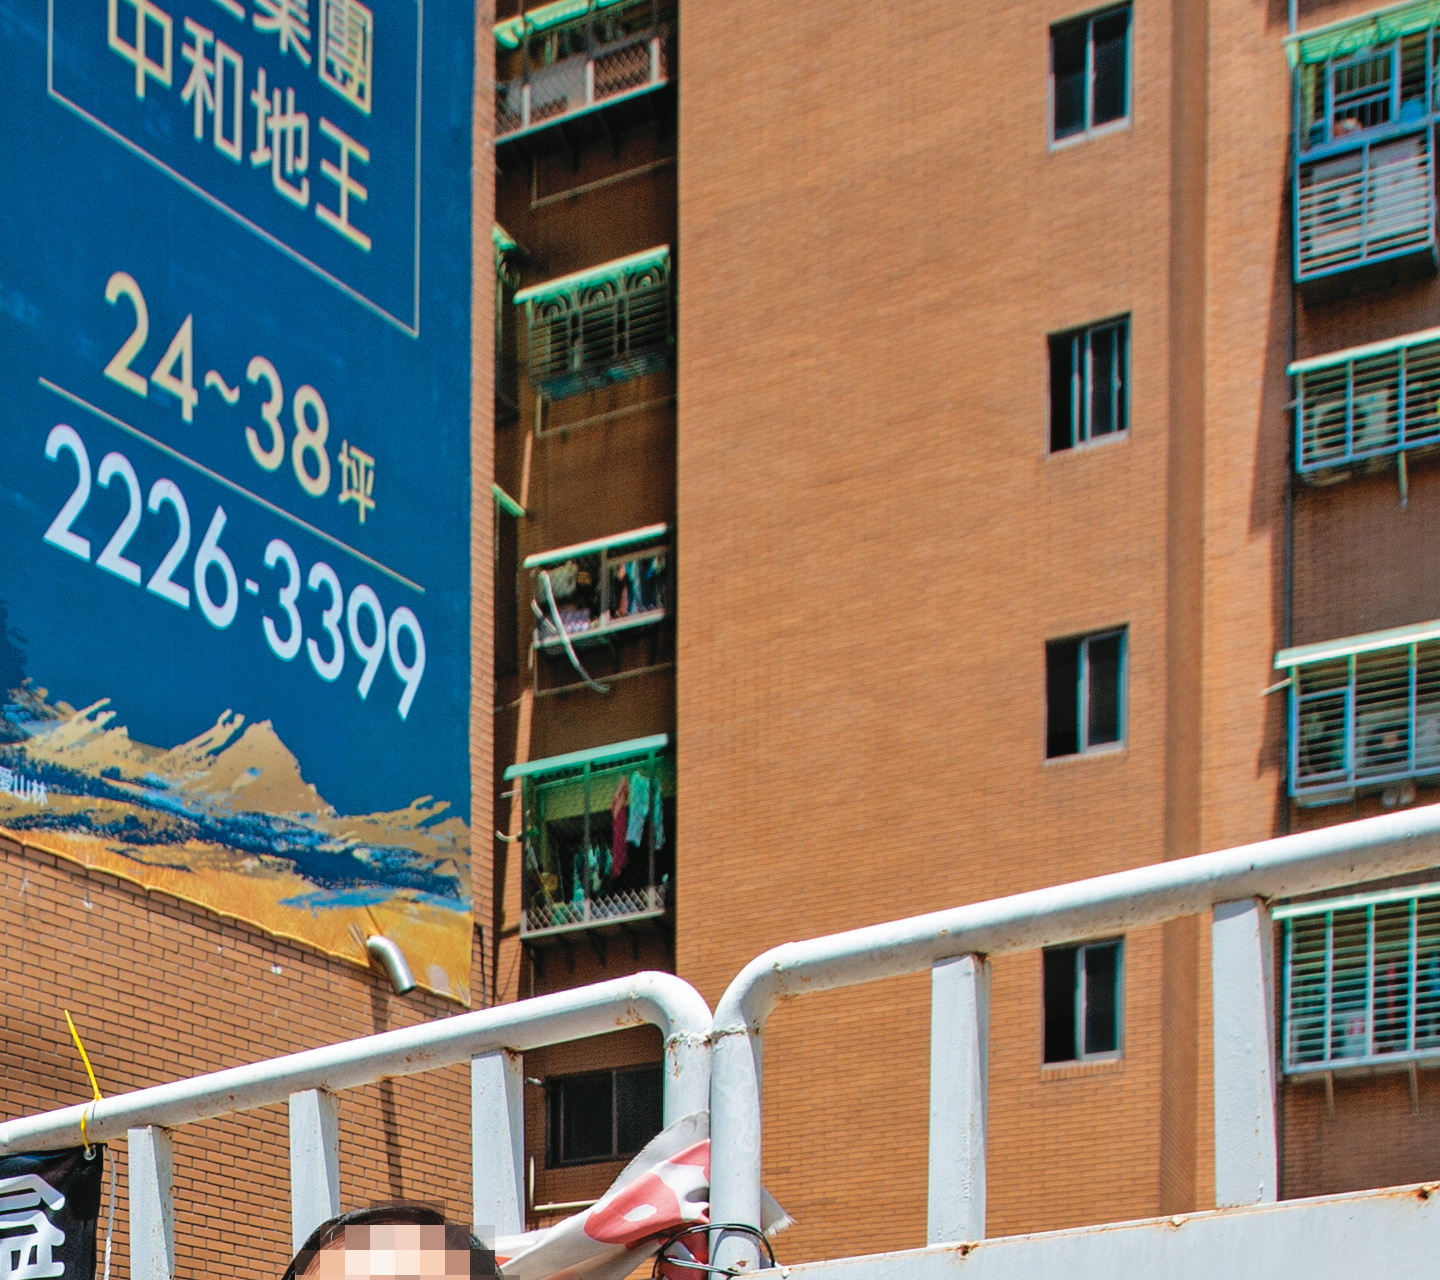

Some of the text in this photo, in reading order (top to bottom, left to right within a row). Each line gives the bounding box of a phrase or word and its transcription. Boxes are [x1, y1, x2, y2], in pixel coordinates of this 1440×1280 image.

[108, 0, 372, 250] 中和地王
[42, 424, 426, 722] 2226-3399
